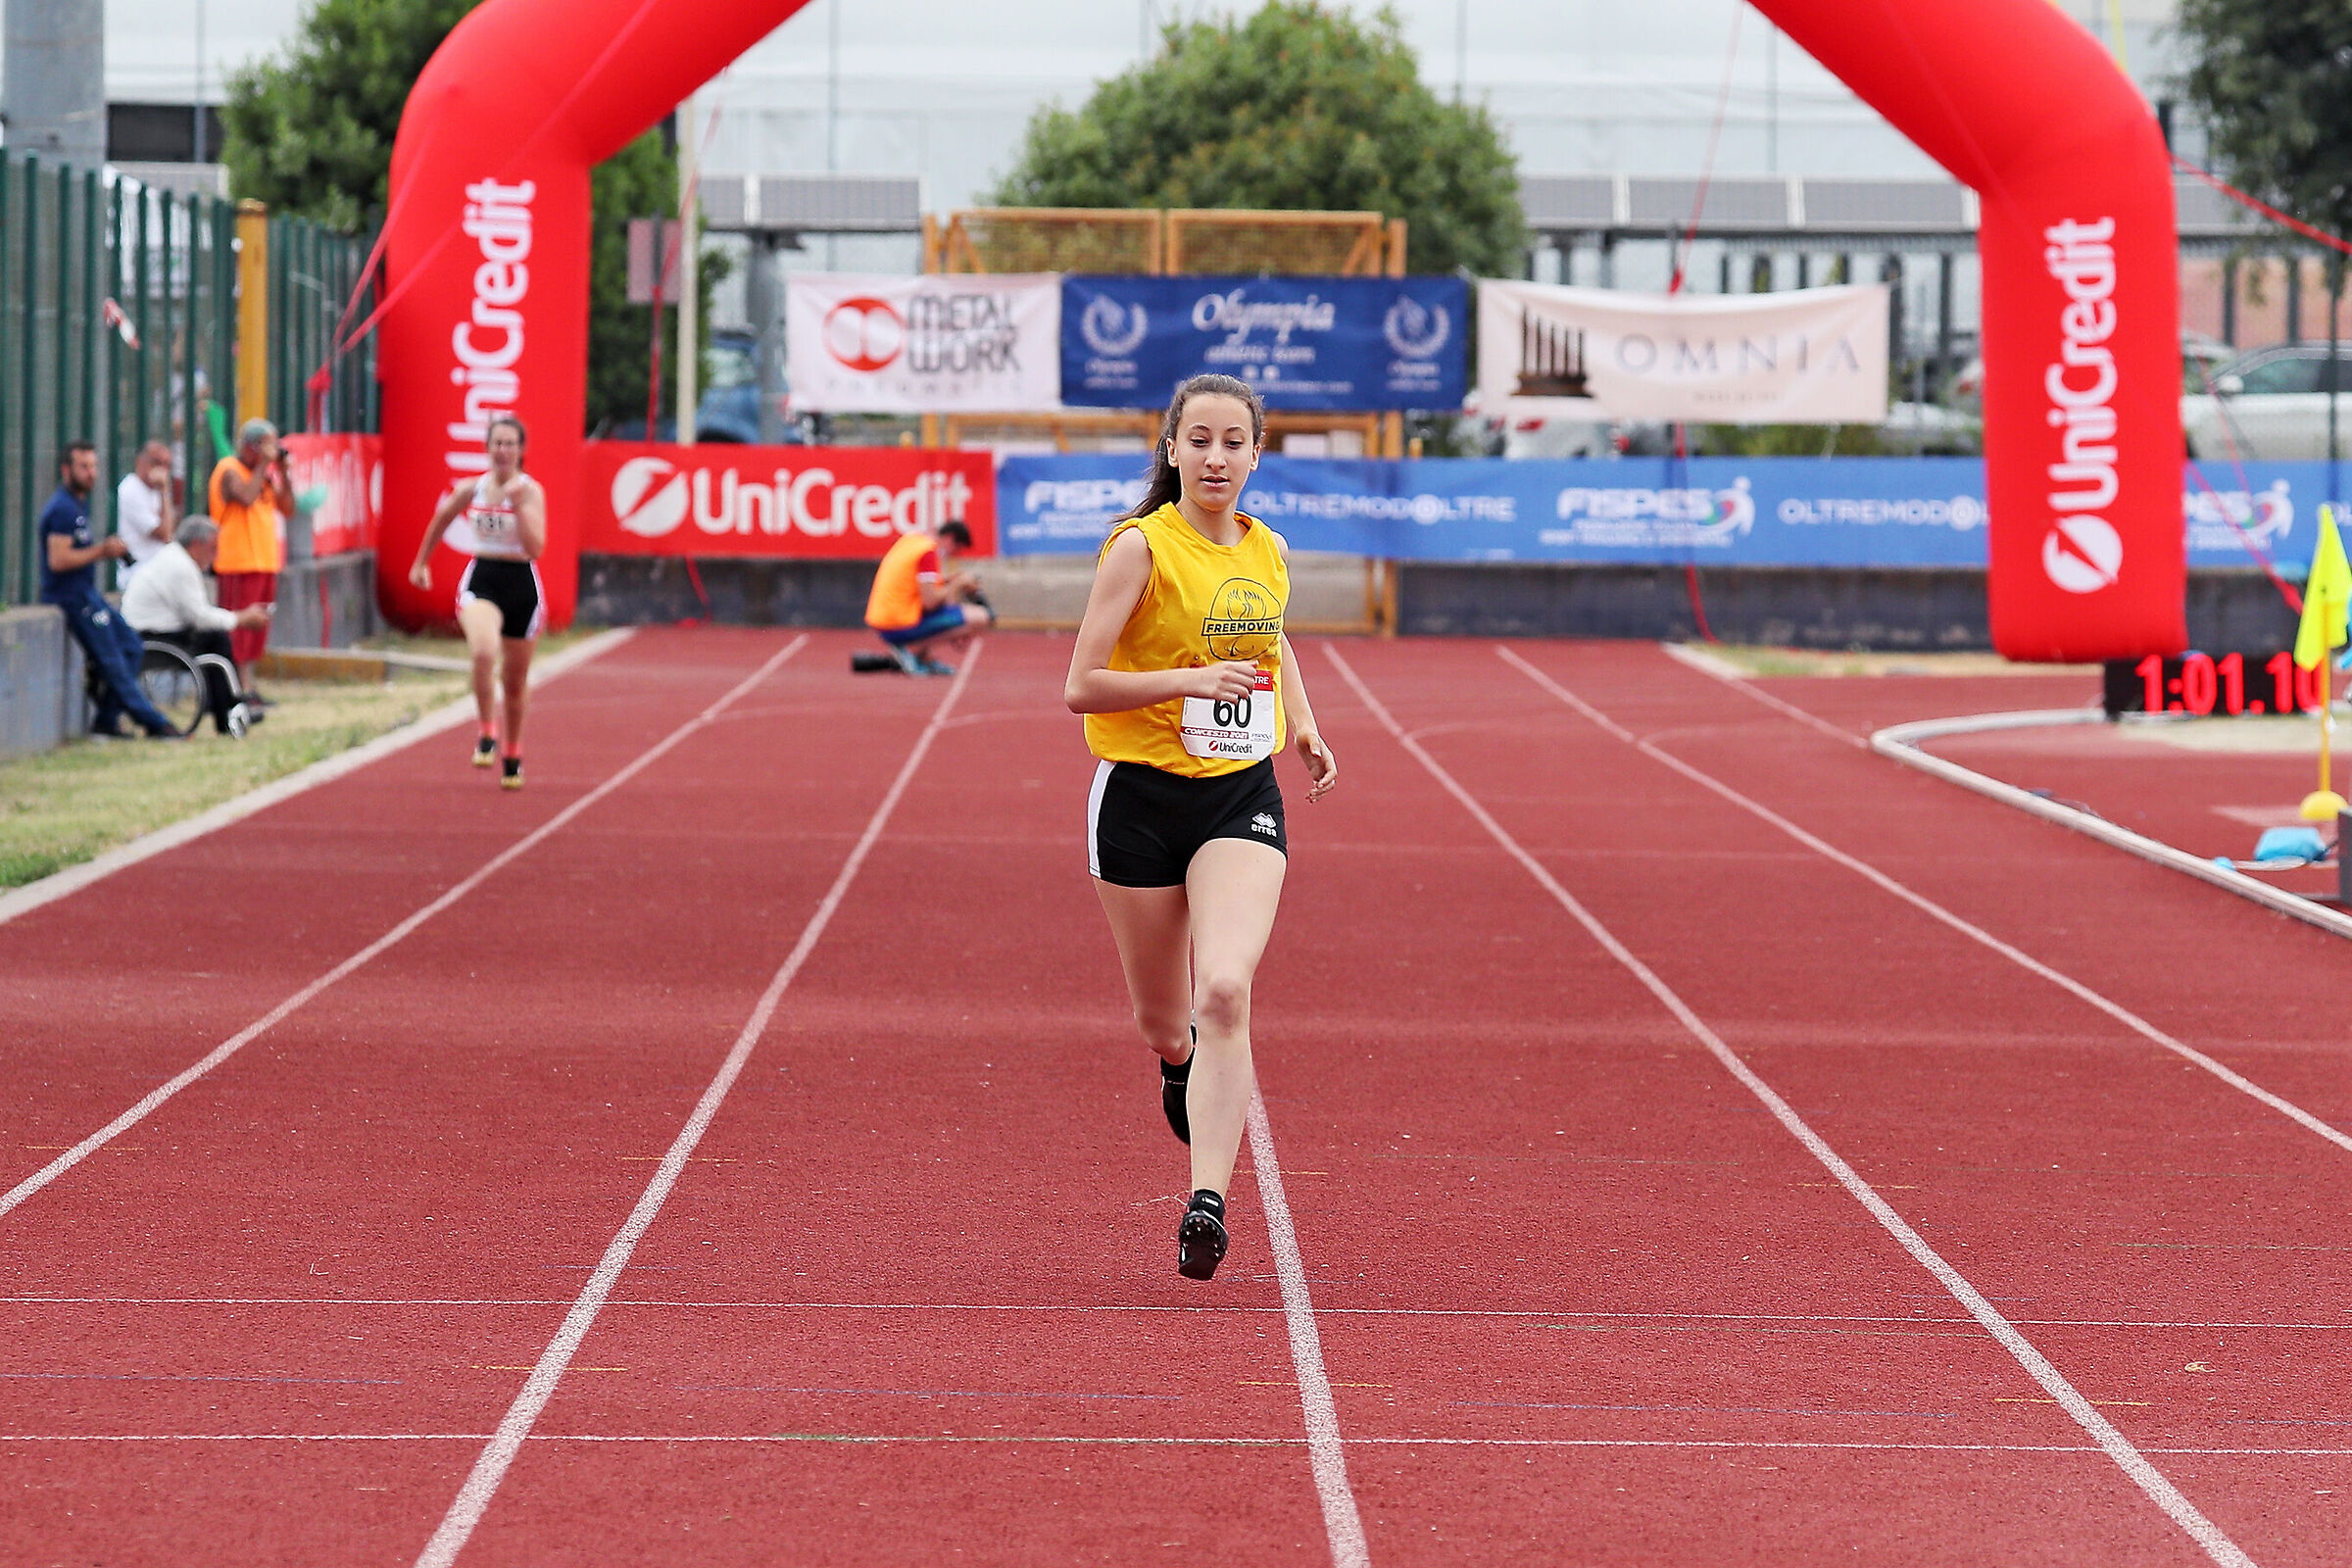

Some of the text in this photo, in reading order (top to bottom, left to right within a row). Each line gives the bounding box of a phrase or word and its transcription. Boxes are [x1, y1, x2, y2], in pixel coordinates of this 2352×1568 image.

[907, 296, 1012, 330] METAL
[1192, 288, 1336, 346] Olympia
[907, 330, 1022, 372] WORK
[1614, 333, 1862, 374] OMNIA
[2044, 216, 2119, 511] UniCredit
[692, 466, 972, 538] UniCredit
[1556, 487, 1713, 520] FISPES
[2134, 651, 2325, 715] 1:01.10
[1213, 694, 1251, 728] 60
[1219, 742, 1252, 754] UniCredit
